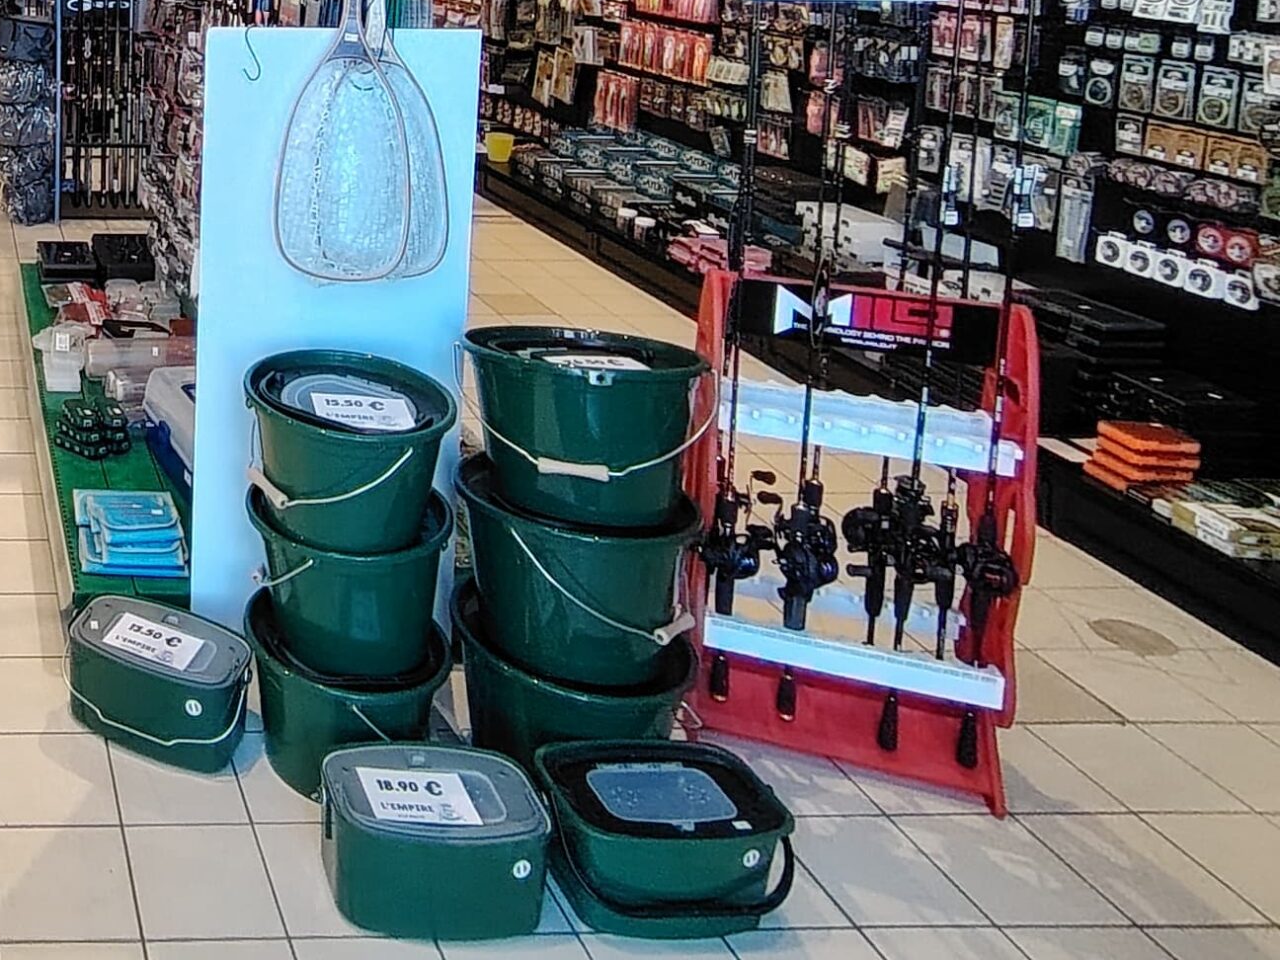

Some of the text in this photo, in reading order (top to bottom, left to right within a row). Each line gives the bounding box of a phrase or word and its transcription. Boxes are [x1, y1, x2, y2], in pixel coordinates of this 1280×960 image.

[376, 779, 443, 796] 18.90 €
[380, 801, 435, 813] L'EMPIRE
